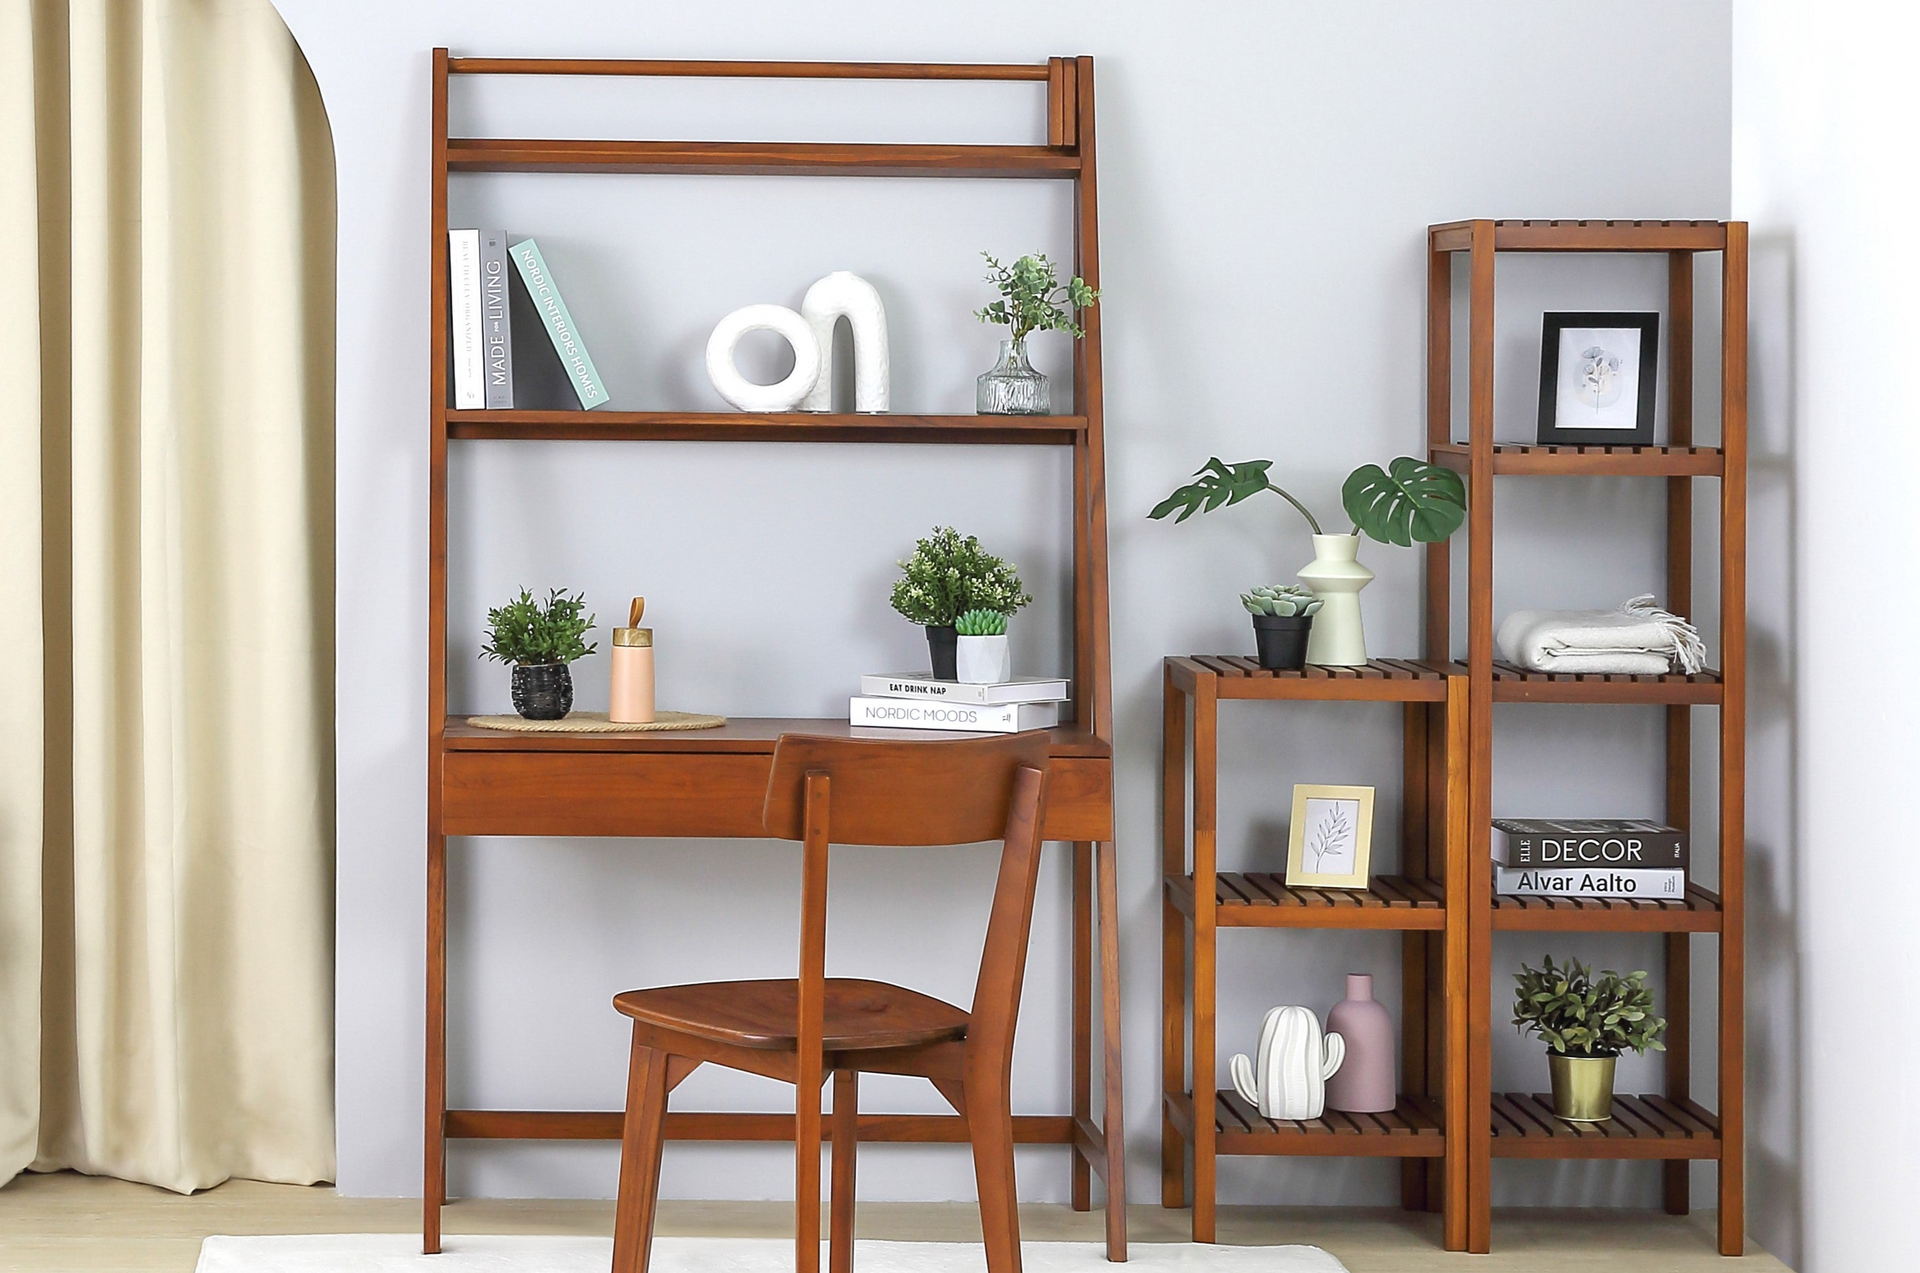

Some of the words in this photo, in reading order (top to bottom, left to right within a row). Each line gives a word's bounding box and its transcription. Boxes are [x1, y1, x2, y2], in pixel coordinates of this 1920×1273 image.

[486, 260, 503, 319] LIVING
[522, 249, 550, 298] NORDIC
[543, 296, 577, 356] INTERIORS
[571, 356, 598, 399] HOMES
[490, 335, 506, 386] MADE
[889, 683, 902, 692] EAT
[905, 684, 928, 694] DRINK
[930, 686, 946, 695] NAP
[865, 706, 920, 721] NORDIC
[923, 709, 977, 723] MOODS
[1520, 839, 1531, 862] ELLE
[1541, 838, 1643, 862] DECOR
[1517, 871, 1573, 891] Alvar
[1579, 873, 1637, 892] Aalto
